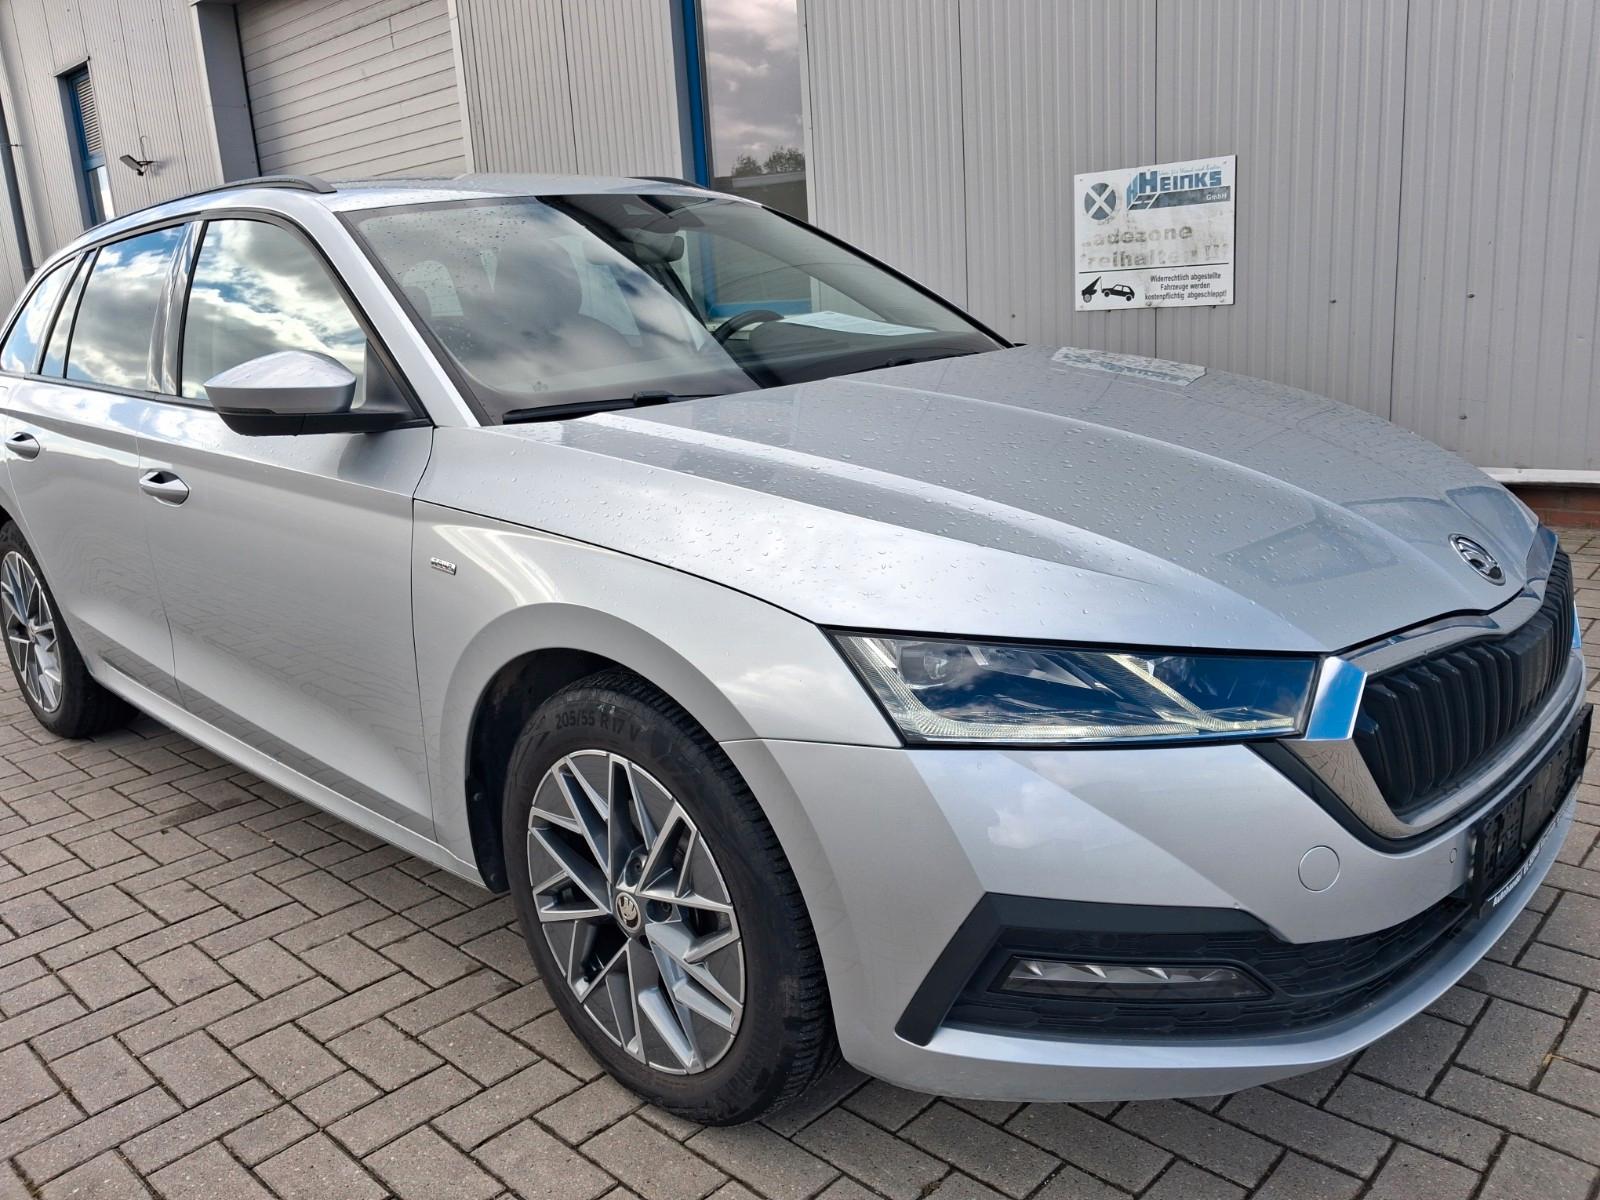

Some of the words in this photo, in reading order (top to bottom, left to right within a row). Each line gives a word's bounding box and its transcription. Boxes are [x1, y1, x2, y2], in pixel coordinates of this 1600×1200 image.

[1206, 192, 1227, 201] GmbH
[1081, 226, 1193, 247] adezone
[1150, 273, 1190, 283] Widerrechtlich
[1190, 272, 1221, 282] abgestellte
[1160, 283, 1189, 291] Fahrzeuge
[1190, 282, 1211, 290] werden
[1144, 291, 1185, 301] kostenpflichtig
[555, 709, 595, 730] 205/55
[600, 713, 609, 729] R
